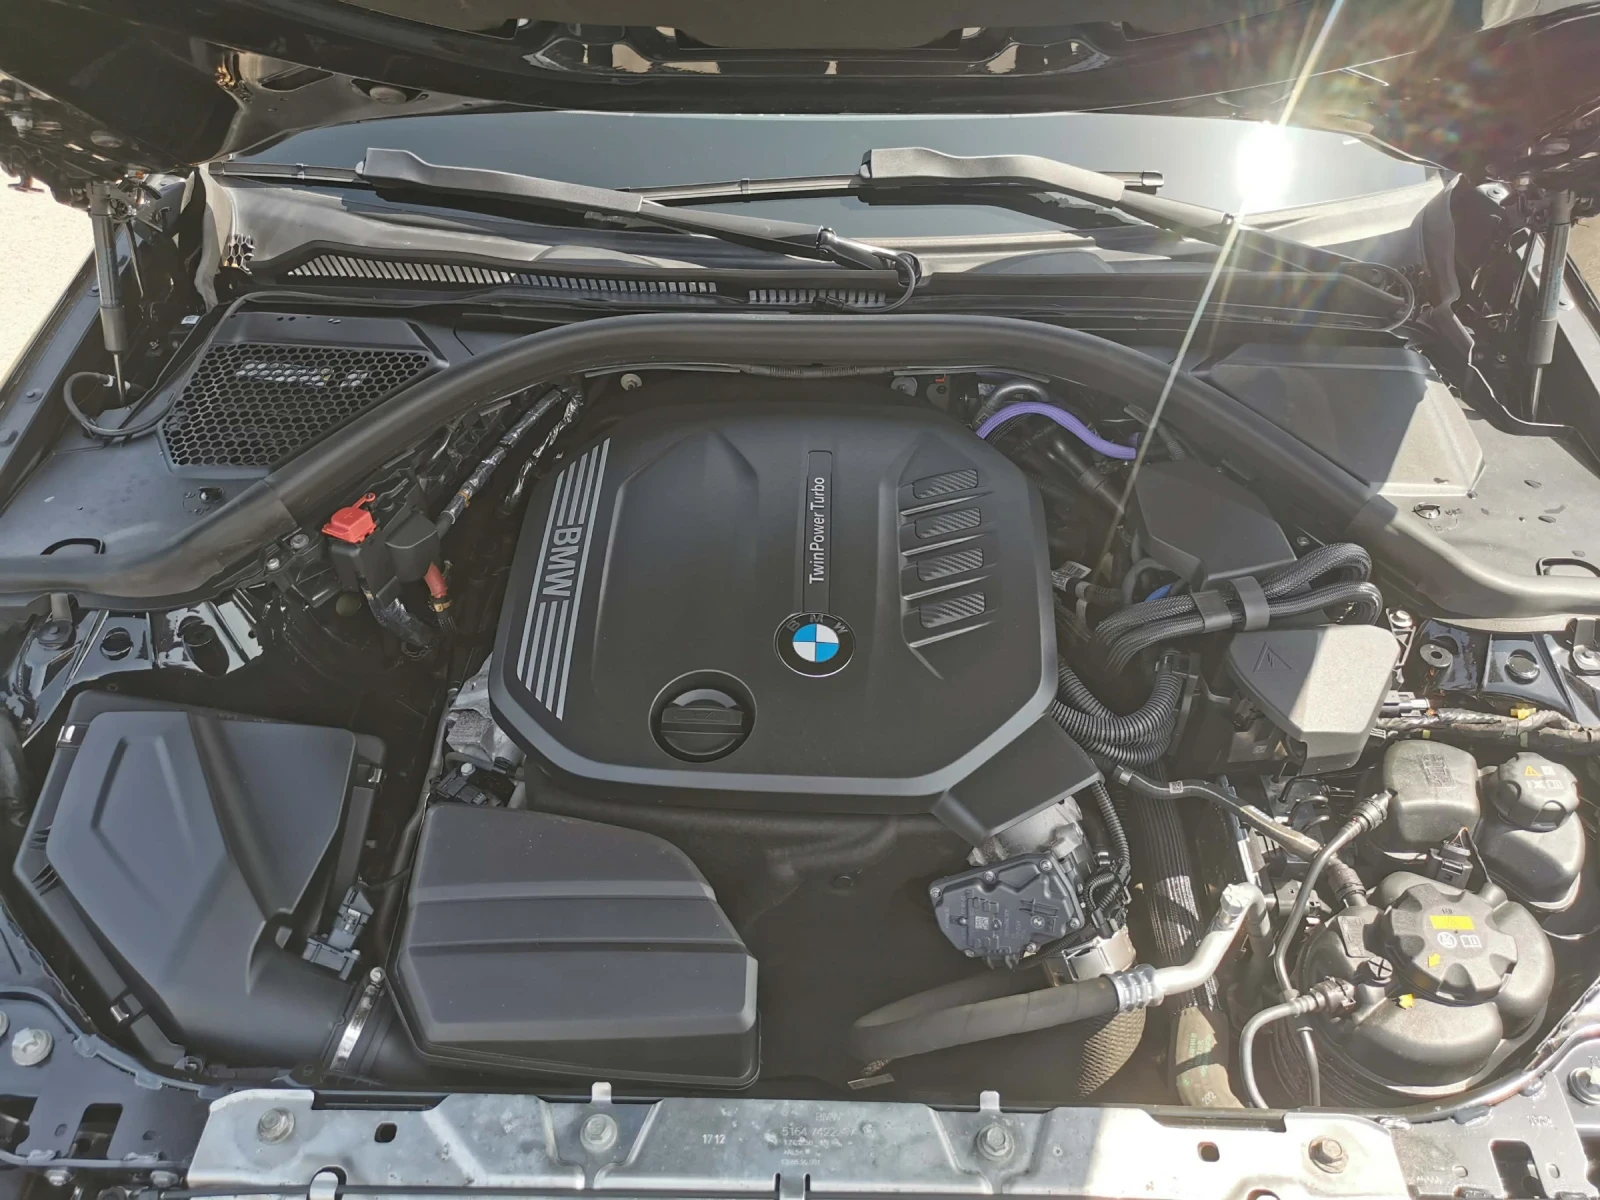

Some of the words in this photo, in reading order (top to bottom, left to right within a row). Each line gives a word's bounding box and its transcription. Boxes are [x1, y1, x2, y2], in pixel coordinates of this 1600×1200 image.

[542, 527, 583, 597] BMW
[786, 614, 849, 634] BMW
[815, 1111, 841, 1121] BMW
[781, 1126, 807, 1137] 5164
[702, 1133, 726, 1145] 1712
